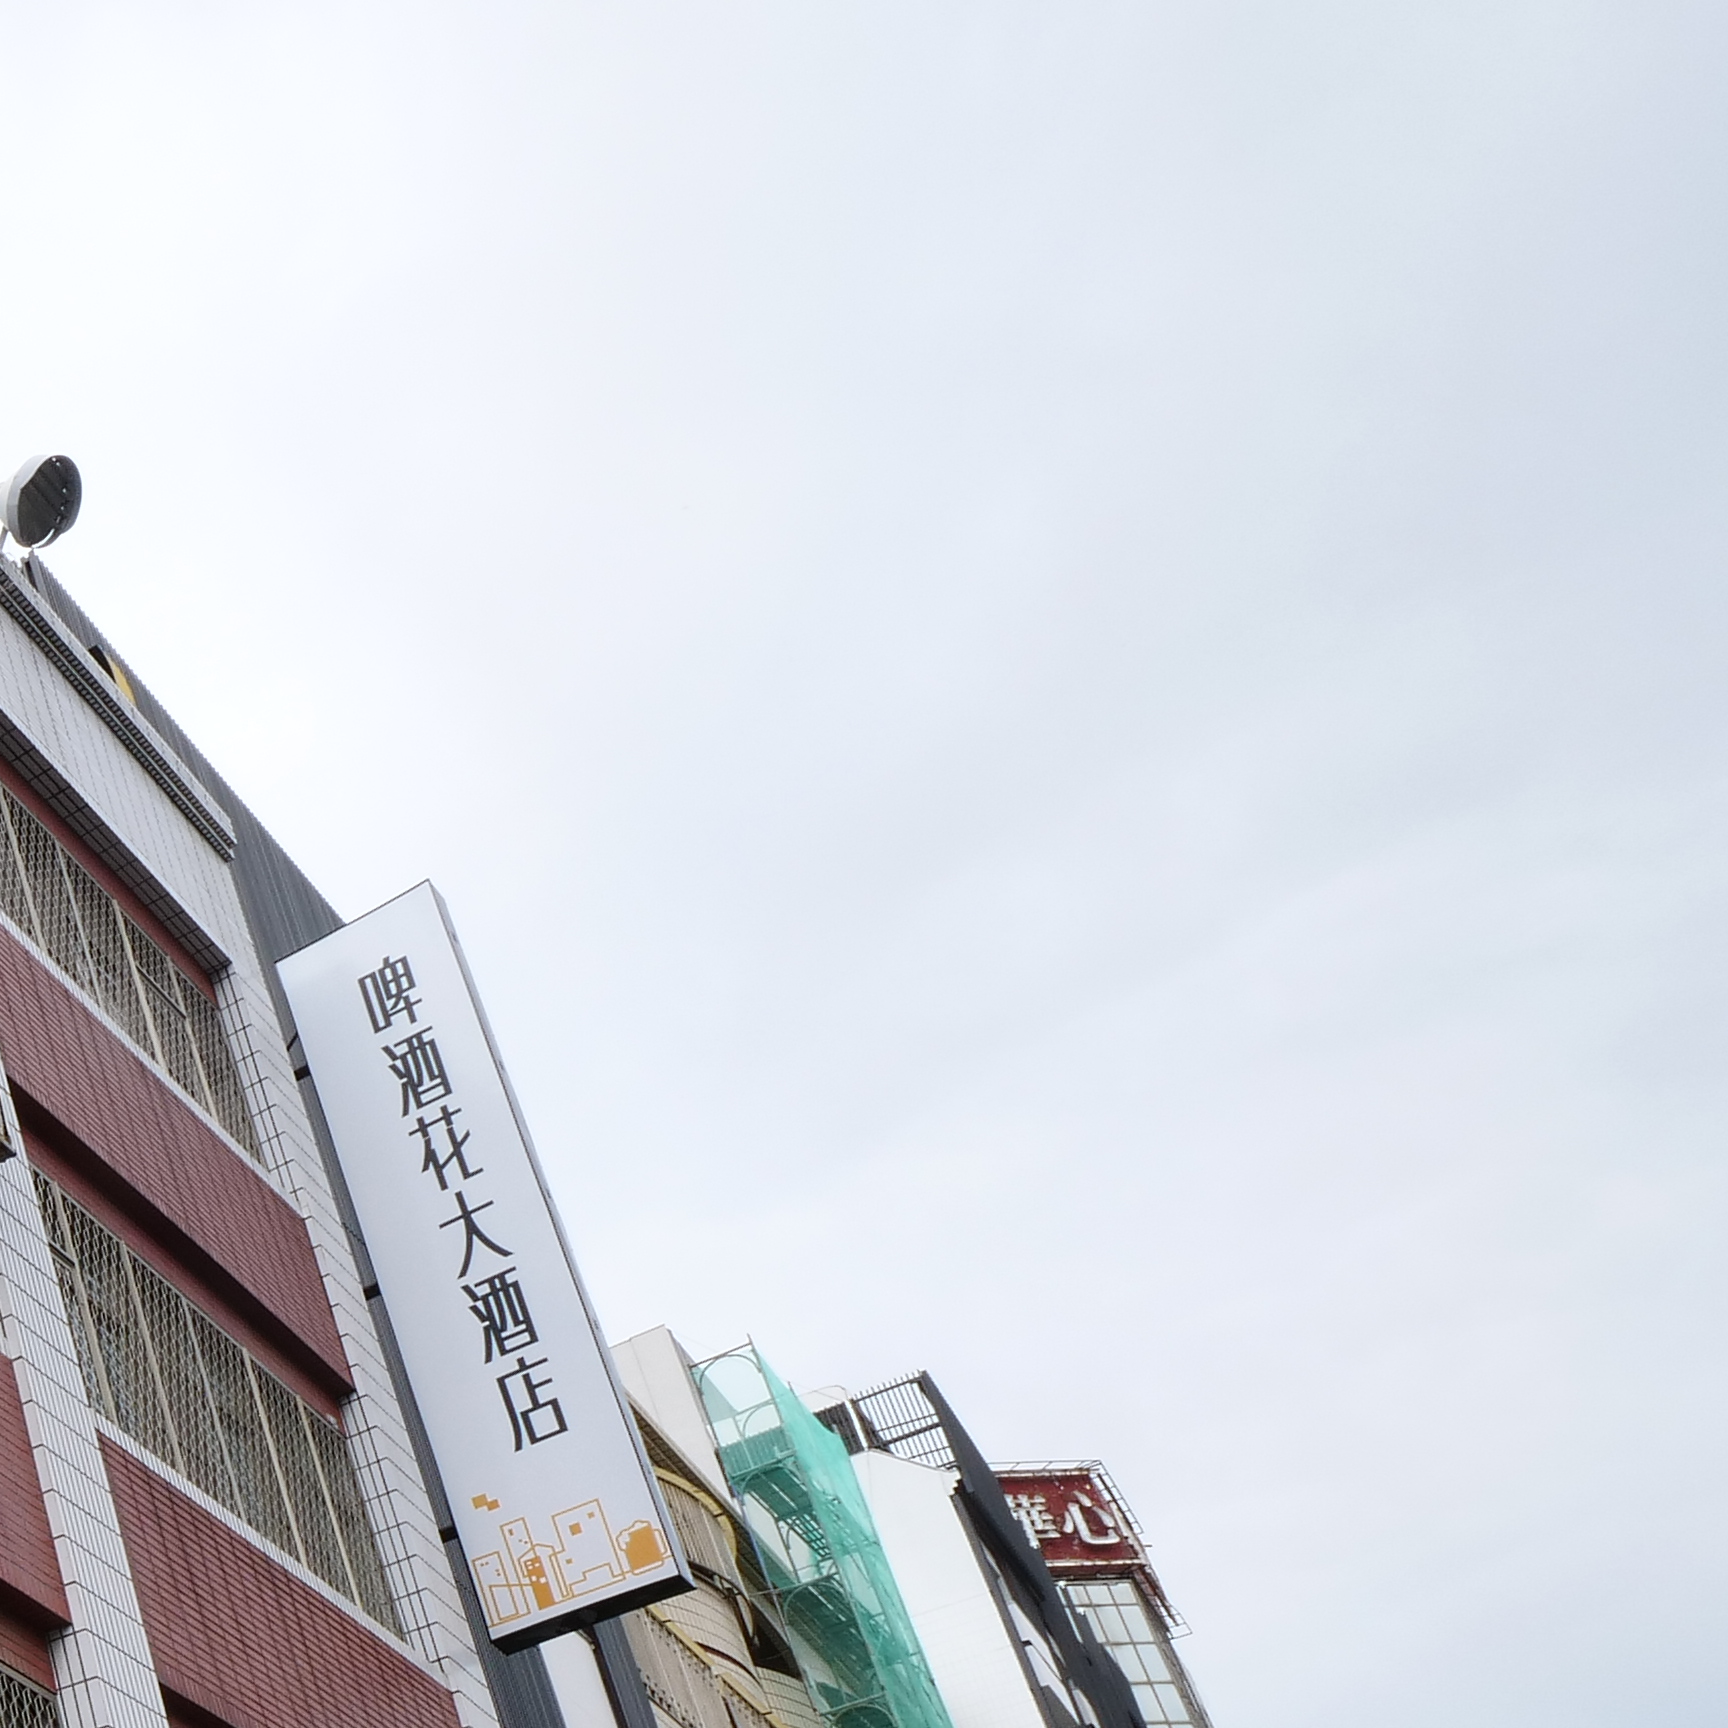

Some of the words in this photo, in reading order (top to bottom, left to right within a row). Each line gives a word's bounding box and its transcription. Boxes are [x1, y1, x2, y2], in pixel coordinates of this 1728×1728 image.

[357, 954, 569, 1454] 啤酒花大酒店
